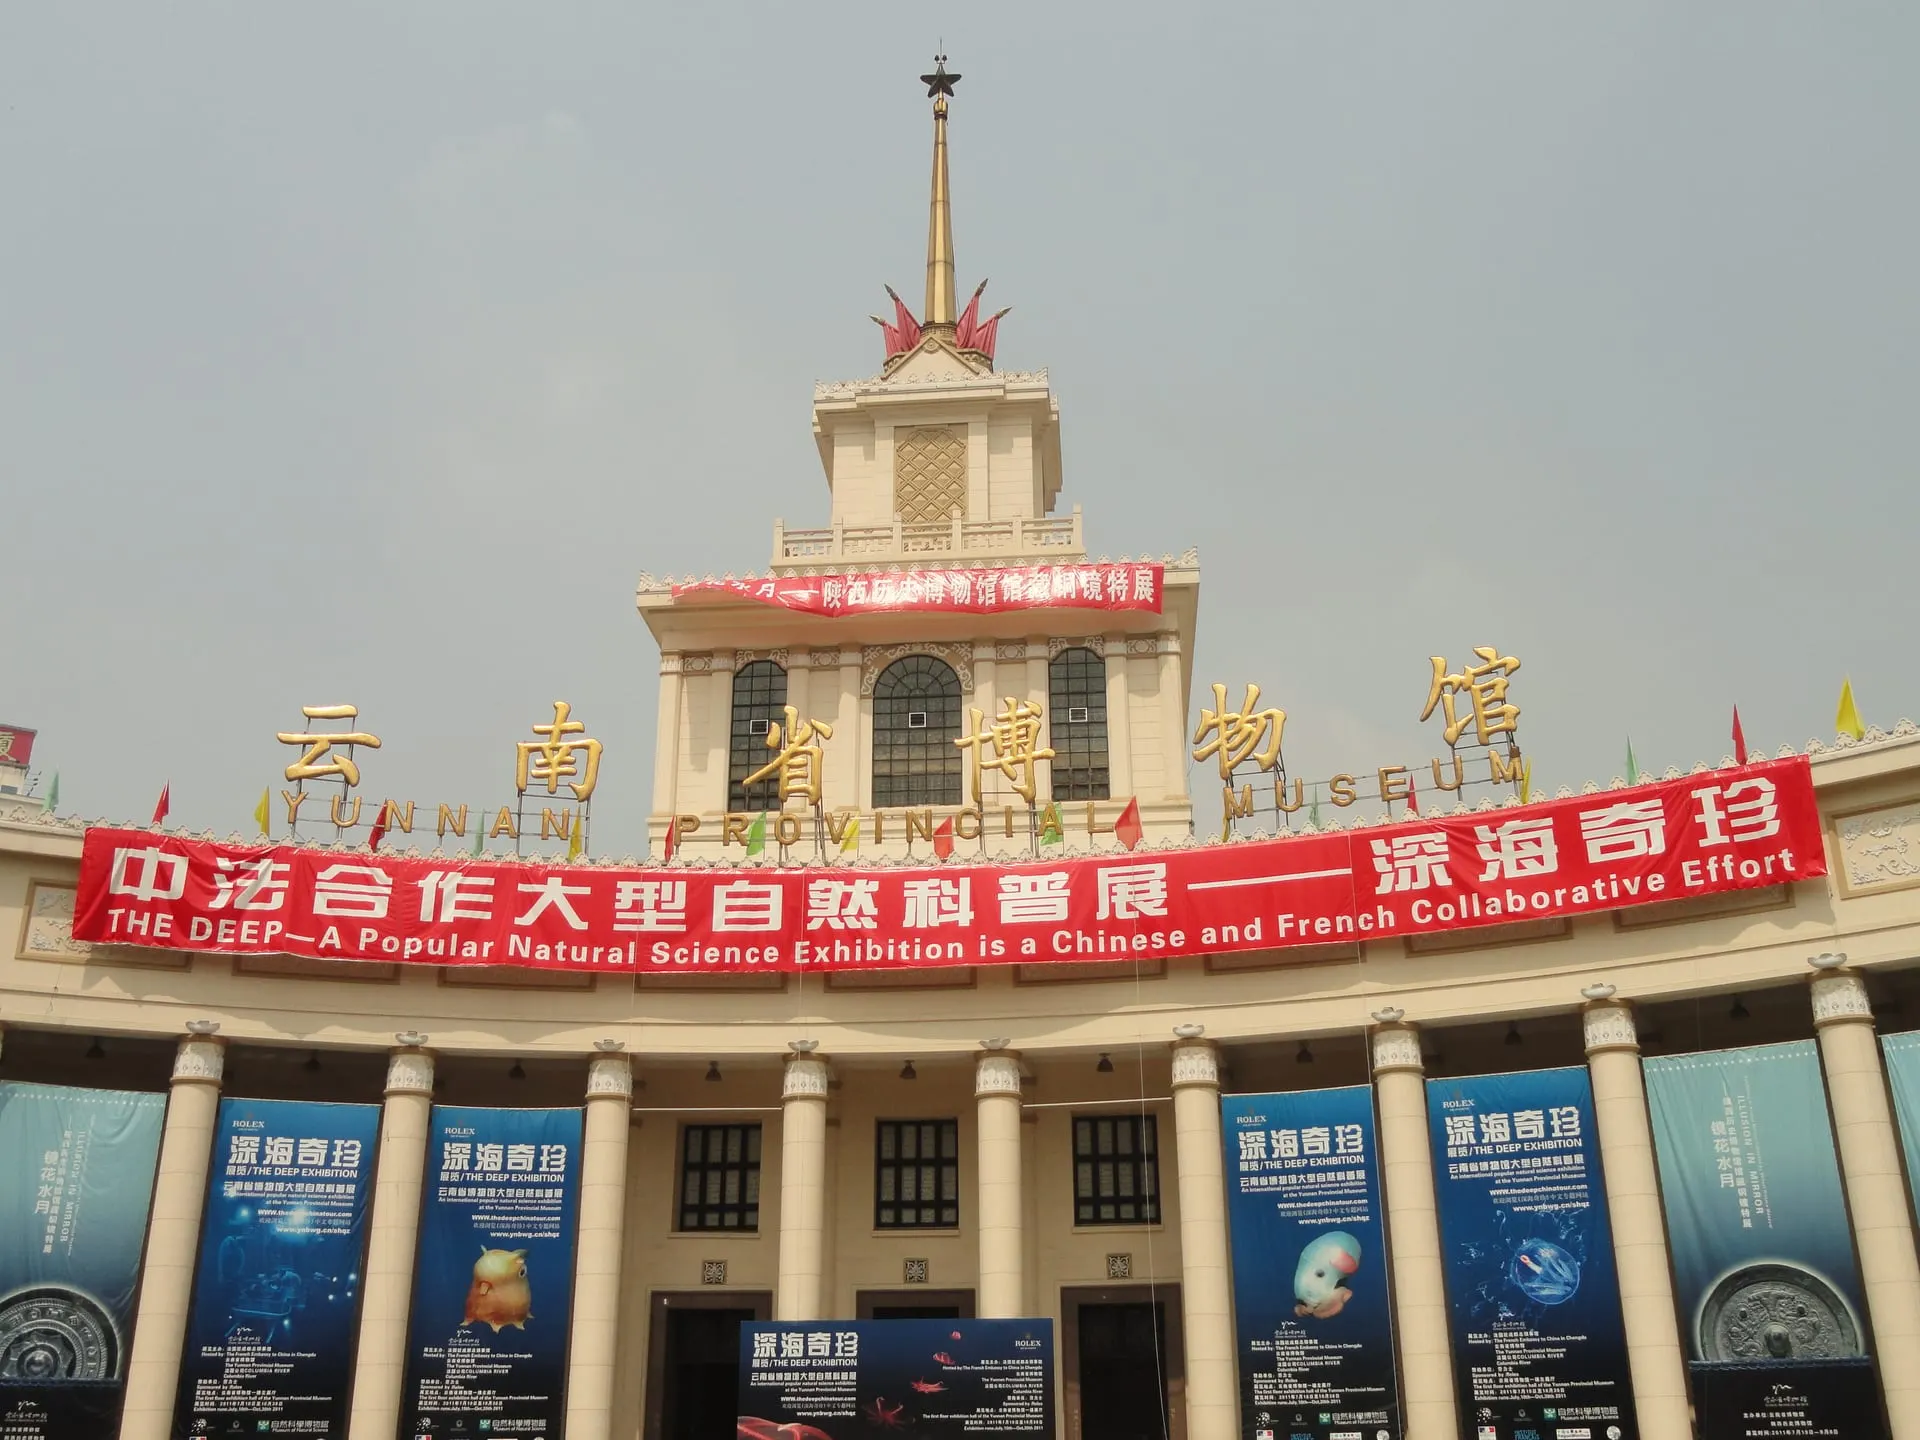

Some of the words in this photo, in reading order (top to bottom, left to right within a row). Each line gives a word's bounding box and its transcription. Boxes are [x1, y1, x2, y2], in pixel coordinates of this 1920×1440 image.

[277, 645, 1521, 806] 云南省博物馆
[281, 790, 570, 841] YUNNAN
[673, 801, 1114, 846] PROVINCIAL
[1222, 746, 1523, 818] MUSEUM
[107, 906, 171, 940] THE
[359, 930, 495, 960] Popular
[508, 935, 636, 965] Natural
[651, 938, 779, 965] Science
[794, 937, 964, 965] Exhibition
[979, 934, 1005, 956] is
[1020, 938, 1038, 955] a
[1052, 926, 1186, 954] Chinese
[1201, 916, 1262, 945] and
[1277, 903, 1396, 938] French
[1411, 872, 1666, 924] Collaborative
[1682, 848, 1796, 887] Effort
[1443, 1099, 1475, 1109] ROLEX
[232, 1120, 264, 1128] ROLEX
[1236, 1115, 1267, 1124] ROLEX
[1444, 1106, 1581, 1146] 深海奇珍
[445, 1127, 475, 1135] ROLEX
[228, 1135, 362, 1168] 深海奇珍
[1238, 1124, 1363, 1160] 深海奇珍
[1495, 1143, 1522, 1154] DEEP
[1524, 1138, 1582, 1151] EXHIBITION
[442, 1142, 567, 1172] 深海奇珍
[1284, 1159, 1308, 1169] DEEP
[1310, 1155, 1364, 1167] EXHIBITION
[1746, 1152, 1756, 1164] IN
[275, 1167, 299, 1176] DEEP
[302, 1168, 358, 1178] EXHIBITION
[486, 1174, 509, 1182] DEEP
[511, 1174, 565, 1182] EXHIBITION
[68, 1184, 77, 1195] IN
[1750, 1171, 1764, 1215] MIRROR
[60, 1201, 74, 1242] MIRROR
[753, 1332, 858, 1357] 深海奇珍
